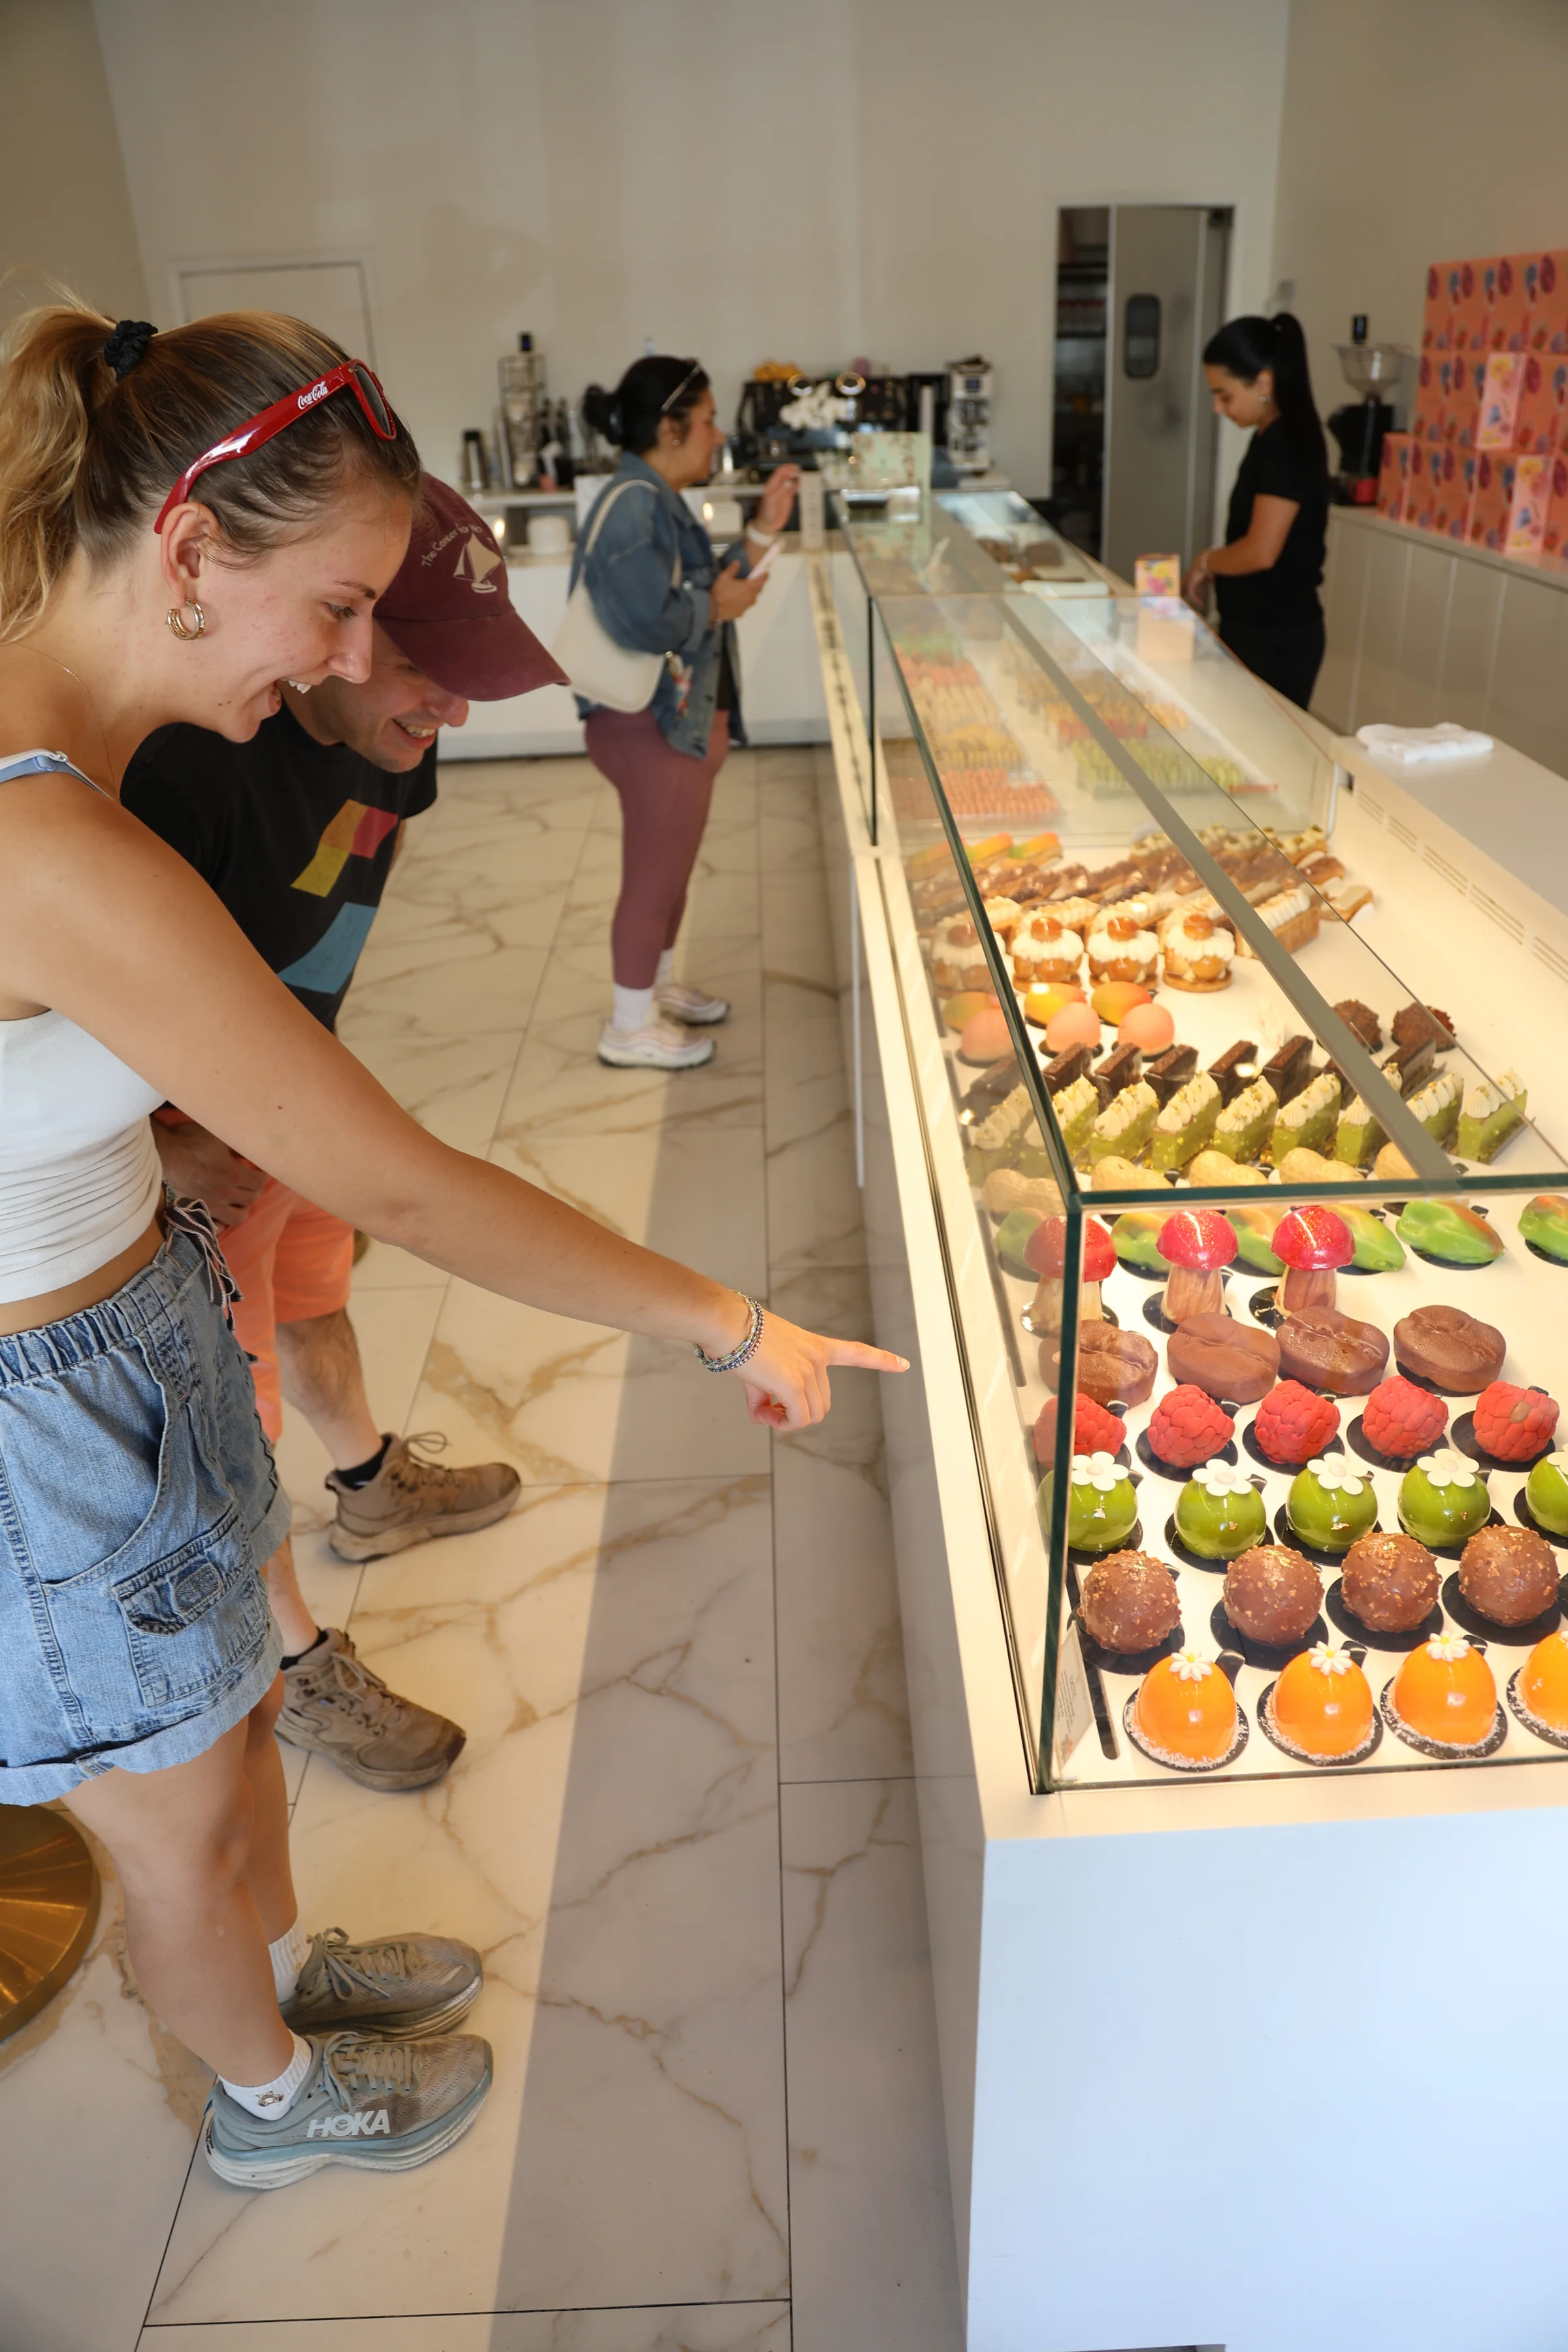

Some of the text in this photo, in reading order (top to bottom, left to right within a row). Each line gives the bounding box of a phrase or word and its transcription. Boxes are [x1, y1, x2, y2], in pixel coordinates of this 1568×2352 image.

[298, 380, 329, 410] Coca-Cola
[421, 550, 437, 566] The
[433, 529, 458, 551] Center
[455, 523, 470, 533] for
[306, 2109, 391, 2138] HOKA
